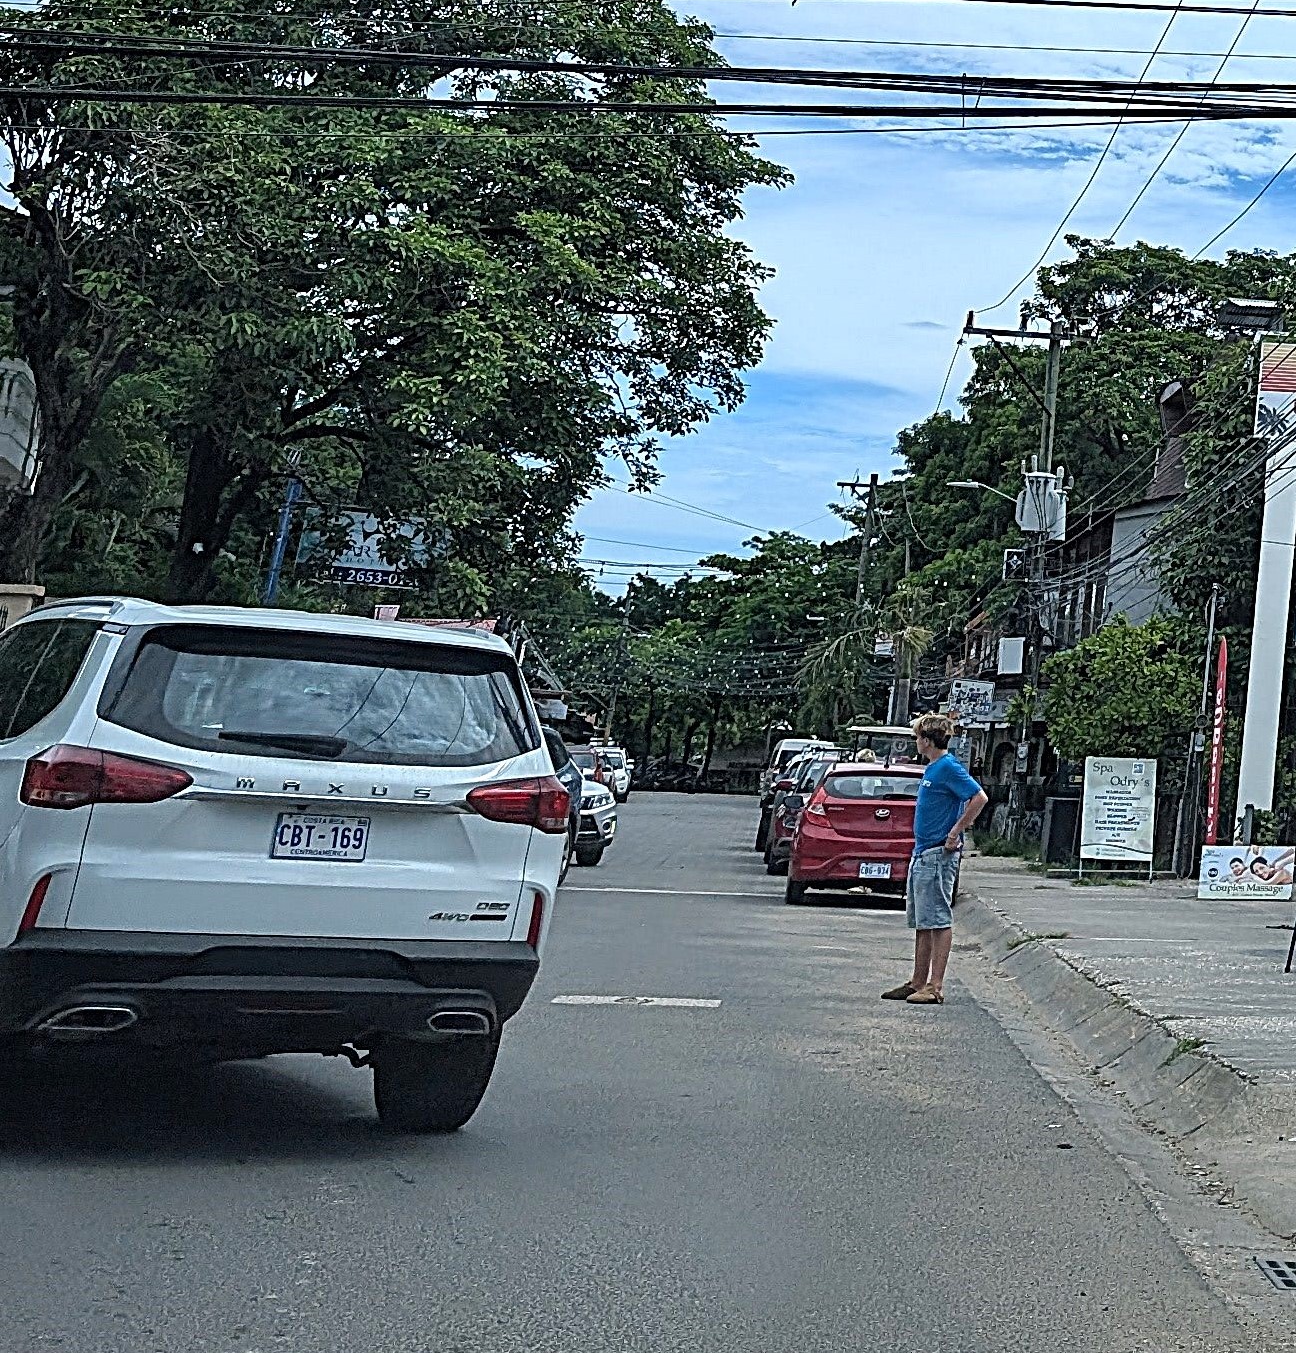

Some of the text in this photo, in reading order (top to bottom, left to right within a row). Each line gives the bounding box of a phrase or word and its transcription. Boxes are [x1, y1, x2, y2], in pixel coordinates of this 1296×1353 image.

[346, 569, 419, 586] 2653-0
[1092, 761, 1114, 775] Spa
[236, 776, 431, 798] MAXUS
[278, 824, 365, 850] CBT-169
[1209, 883, 1284, 895] Couples Massage
